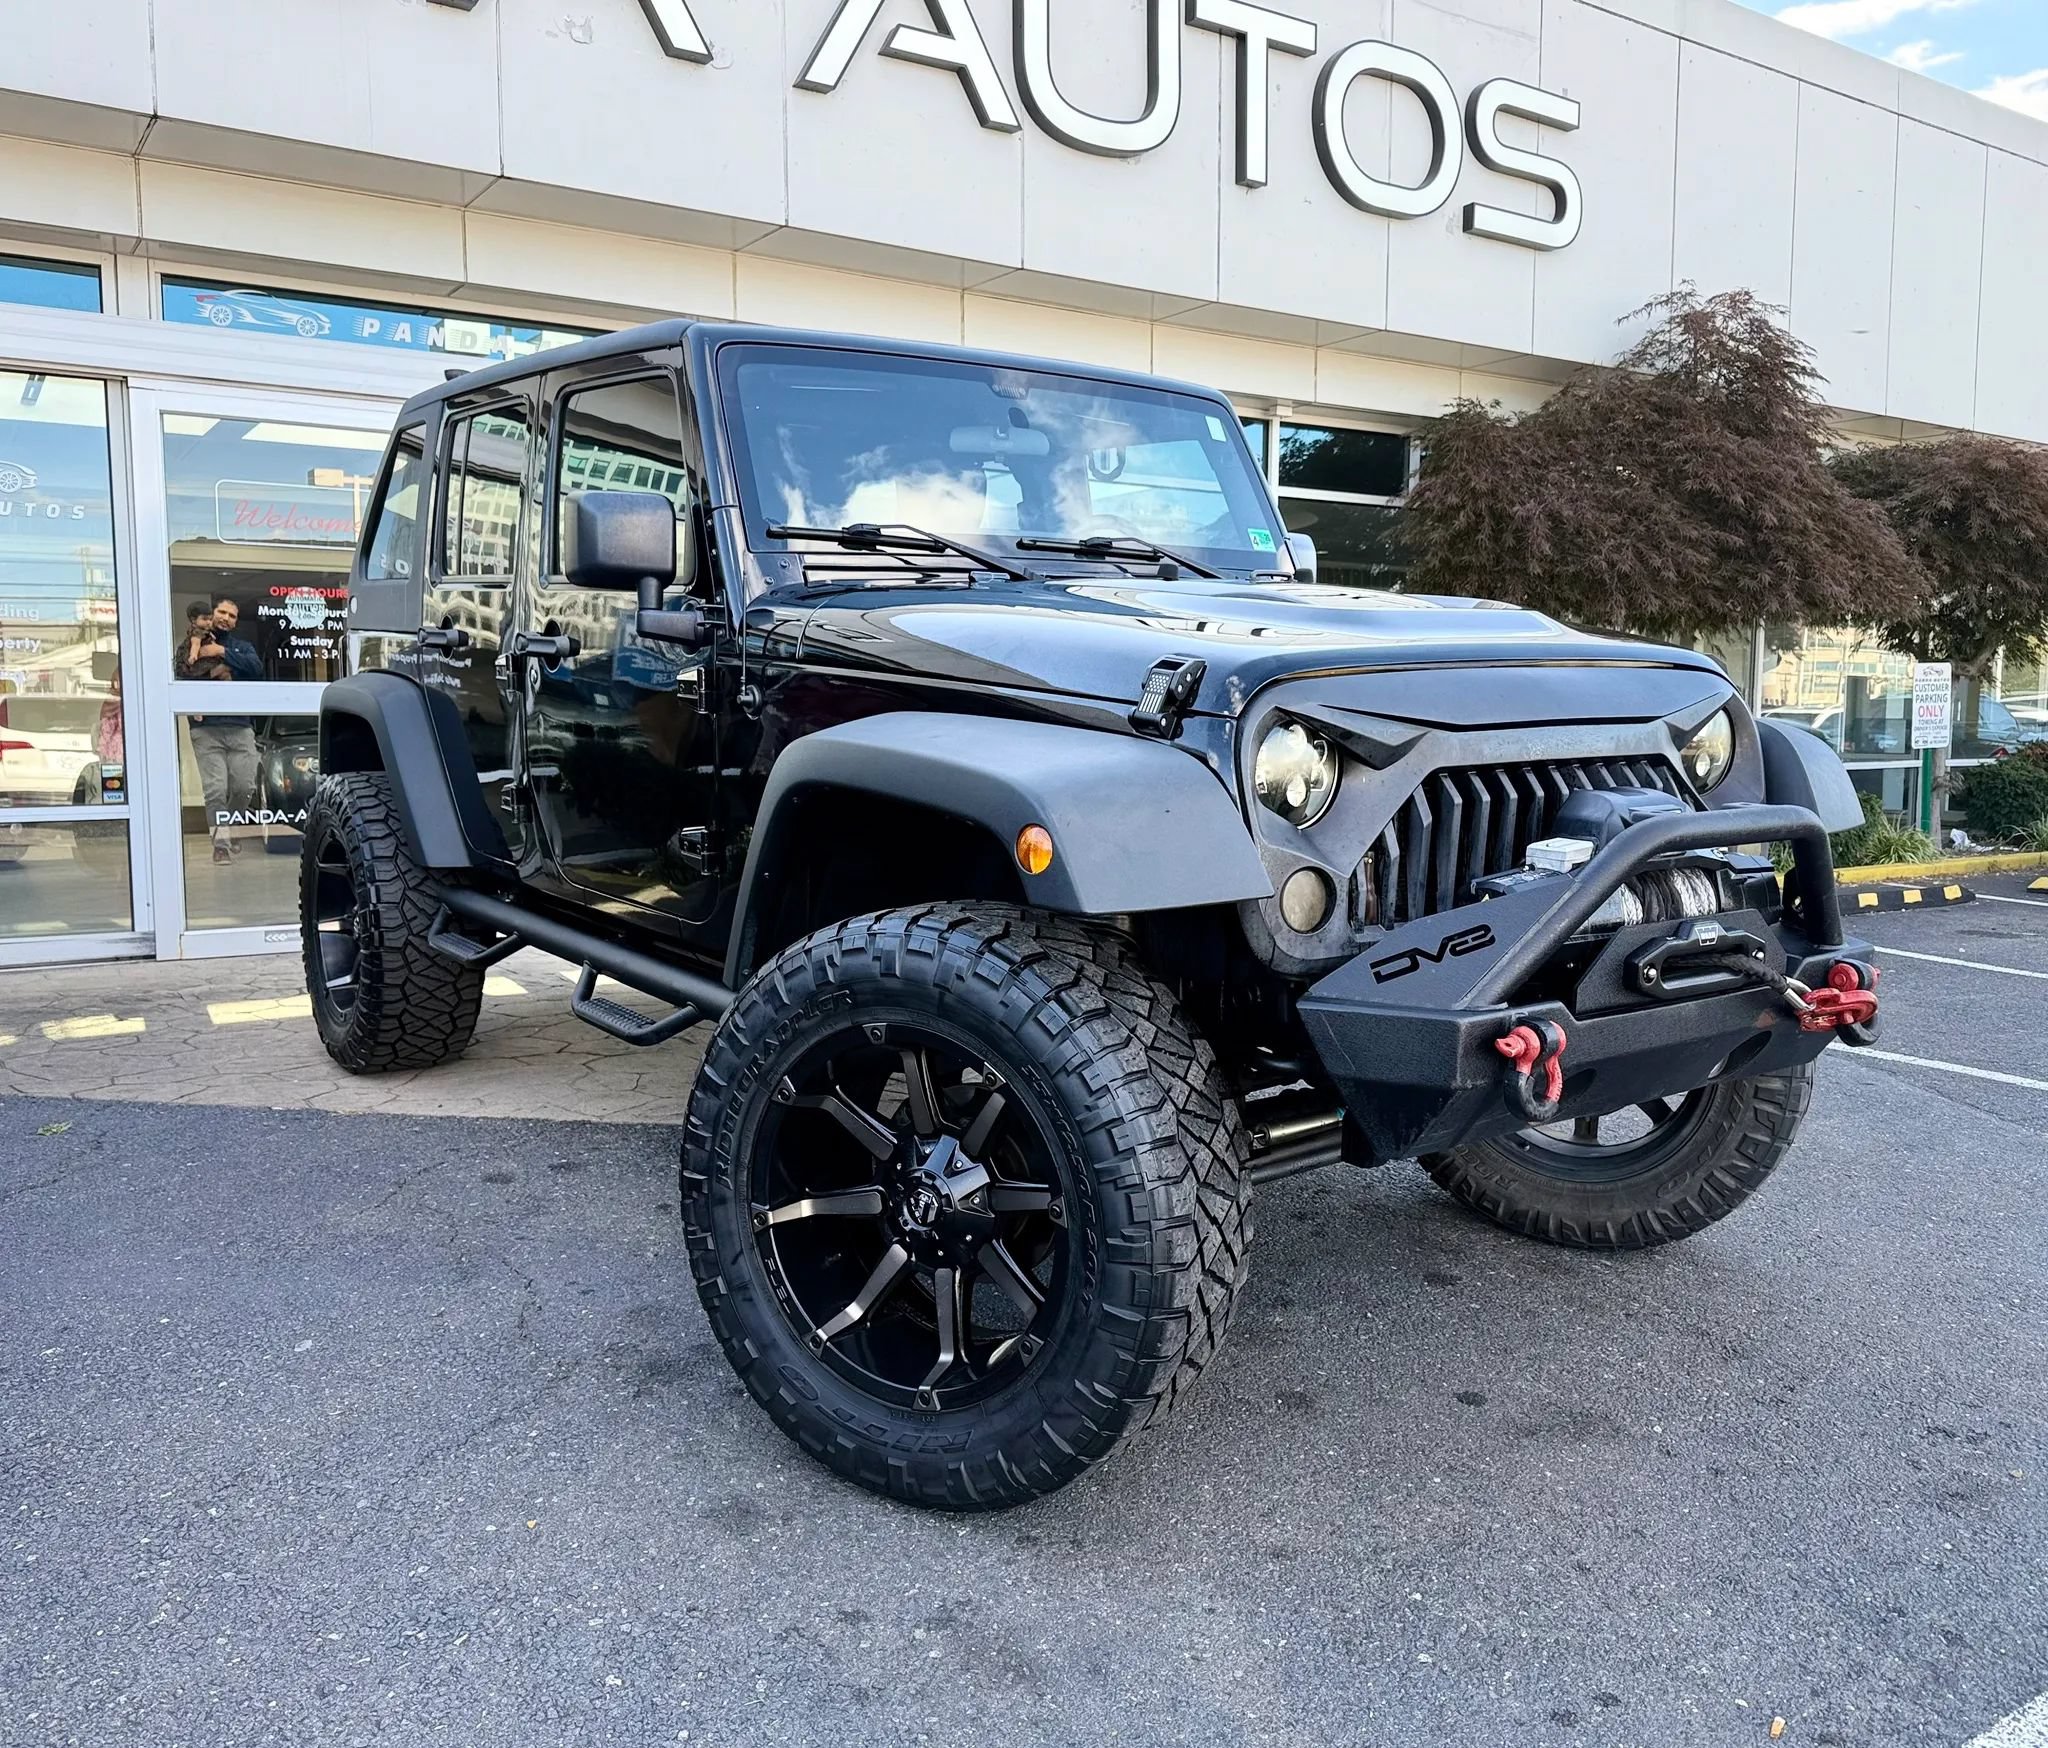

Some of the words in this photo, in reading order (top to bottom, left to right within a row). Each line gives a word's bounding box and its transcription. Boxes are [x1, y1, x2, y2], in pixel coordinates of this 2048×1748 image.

[793, 0, 1583, 251] AUTOS
[279, 620, 286, 630] 9
[327, 620, 344, 630] PM
[290, 635, 334, 649] Sunday
[278, 648, 290, 659] 11
[294, 648, 312, 659] AM
[322, 649, 328, 660] 3
[1914, 683, 1950, 692] CUSTOMER
[1915, 694, 1948, 704] PARKING
[1918, 705, 1945, 718] ONLY
